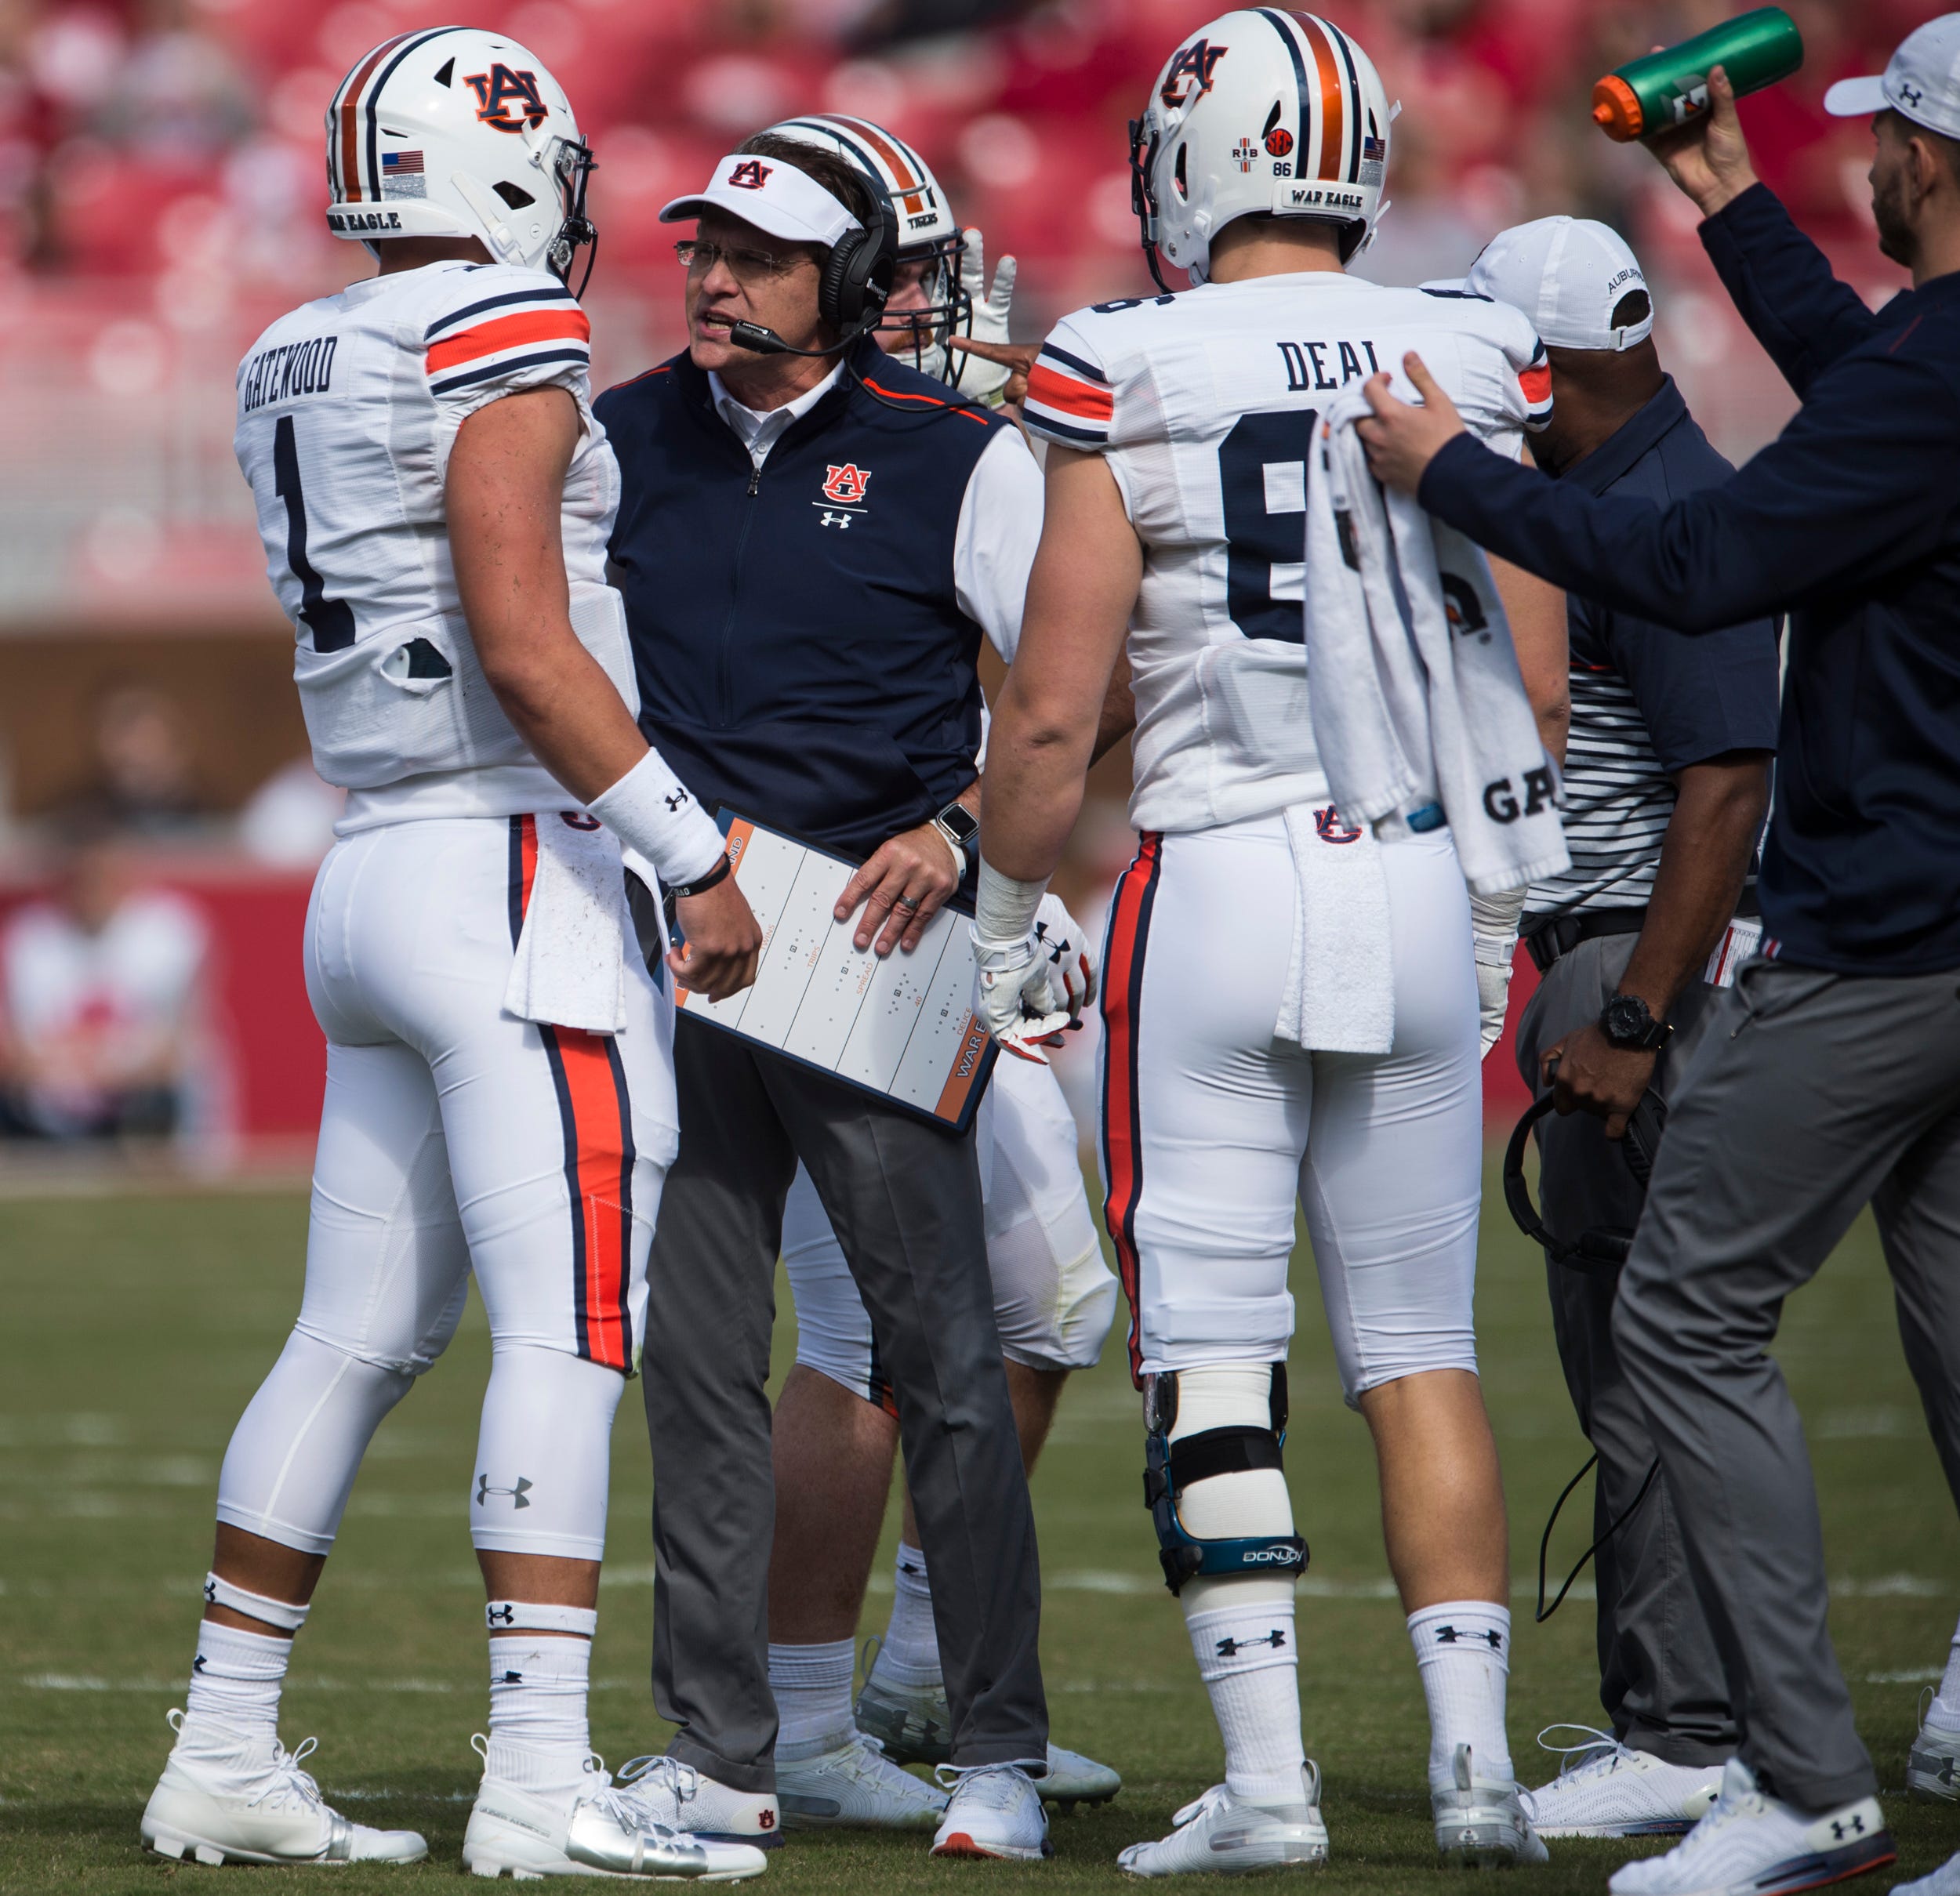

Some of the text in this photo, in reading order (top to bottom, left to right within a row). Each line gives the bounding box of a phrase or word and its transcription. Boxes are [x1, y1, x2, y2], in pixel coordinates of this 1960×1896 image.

[1266, 129, 1292, 156] SEC
[1272, 162, 1292, 177] 86
[1292, 190, 1363, 208] WAR EAGLE
[347, 212, 402, 230] EAGLE
[907, 212, 938, 230] TIGERS
[245, 335, 339, 413] GATEWOOD
[274, 415, 356, 654] 1
[760, 924, 775, 951] TWINS
[807, 946, 821, 968] TRIPS
[856, 963, 874, 995] SPREAD
[914, 996, 923, 1007] 40
[957, 1006, 972, 1035] DEUCE
[956, 1035, 983, 1078] WAR
